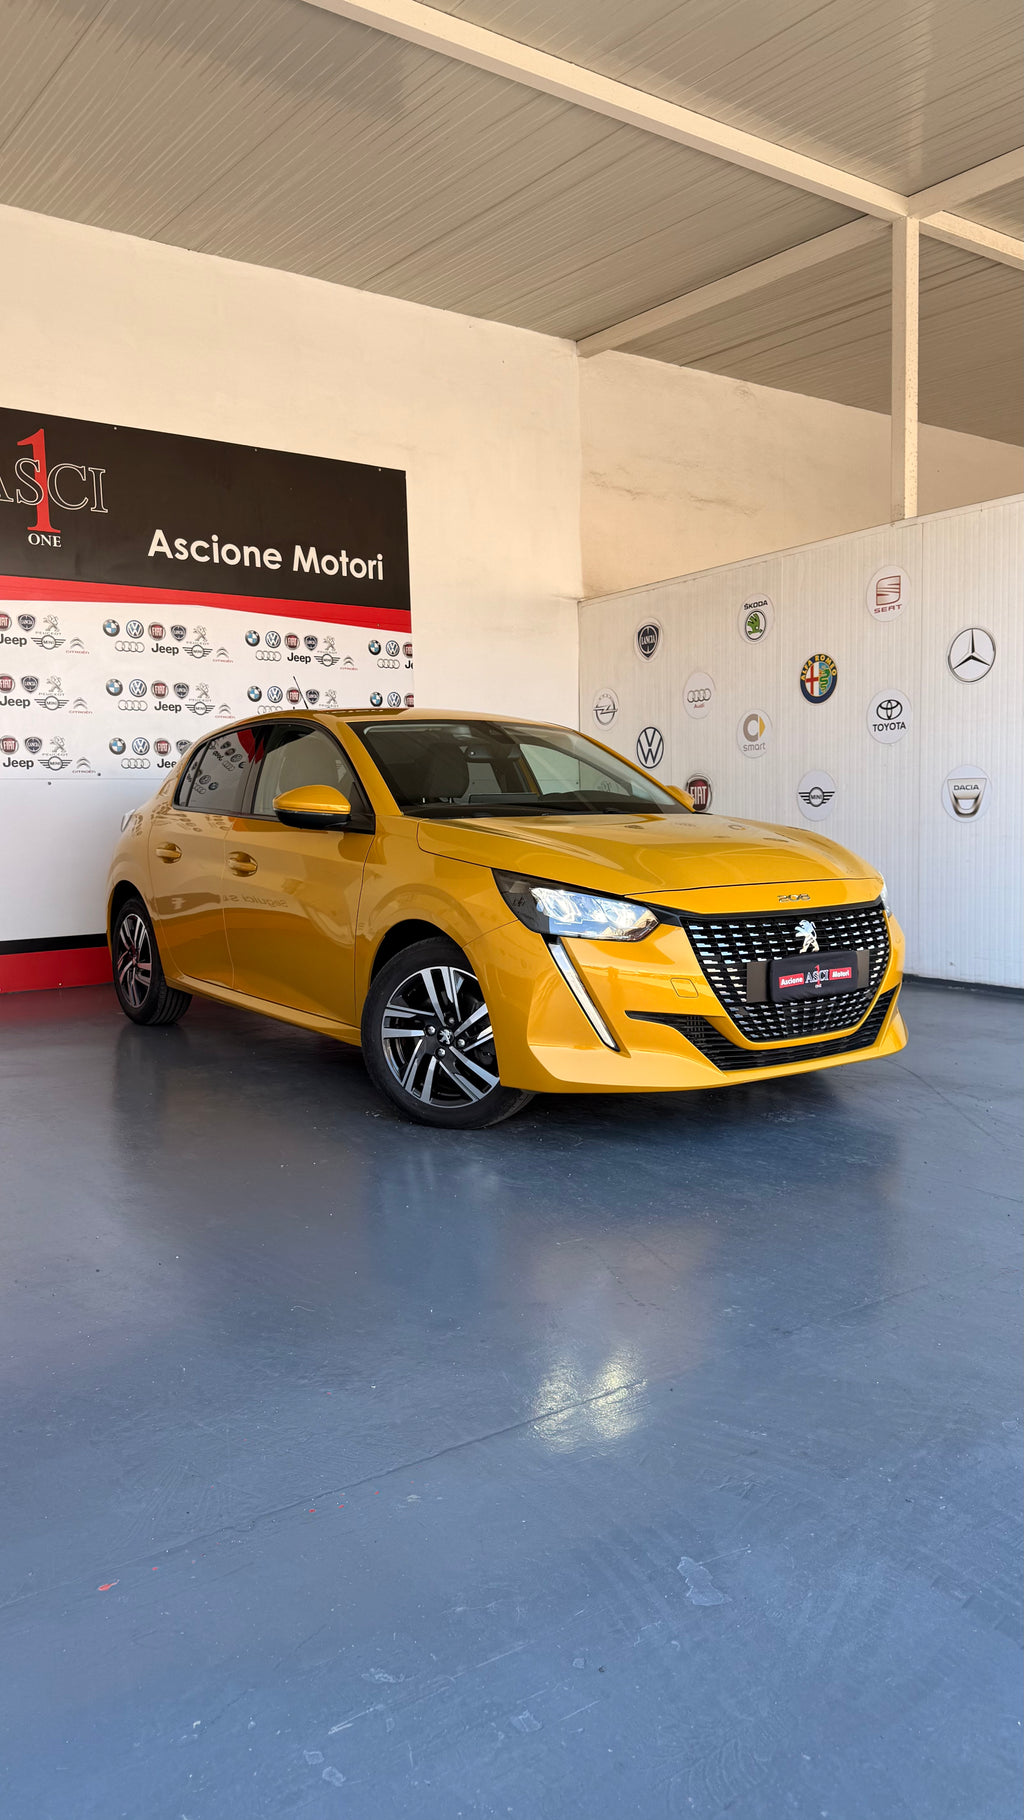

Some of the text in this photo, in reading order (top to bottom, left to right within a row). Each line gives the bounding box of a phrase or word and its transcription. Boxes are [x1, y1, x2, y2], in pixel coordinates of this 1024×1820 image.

[28, 533, 61, 548] ONE
[147, 529, 384, 581] Ascione Motori
[874, 604, 903, 614] SEAT
[0, 633, 28, 647] Jeep
[151, 643, 179, 656] Jeep
[287, 652, 311, 664] Jeep
[815, 655, 837, 676] ROMEO
[0, 696, 31, 709] Jeep
[154, 701, 182, 713] Jeep
[872, 722, 907, 732] TOYOTA
[743, 742, 766, 751] smart
[3, 757, 34, 770] Jeep
[157, 758, 177, 769] Jee
[777, 893, 811, 903] 208
[780, 969, 850, 986] Ascione ASCI Motori
